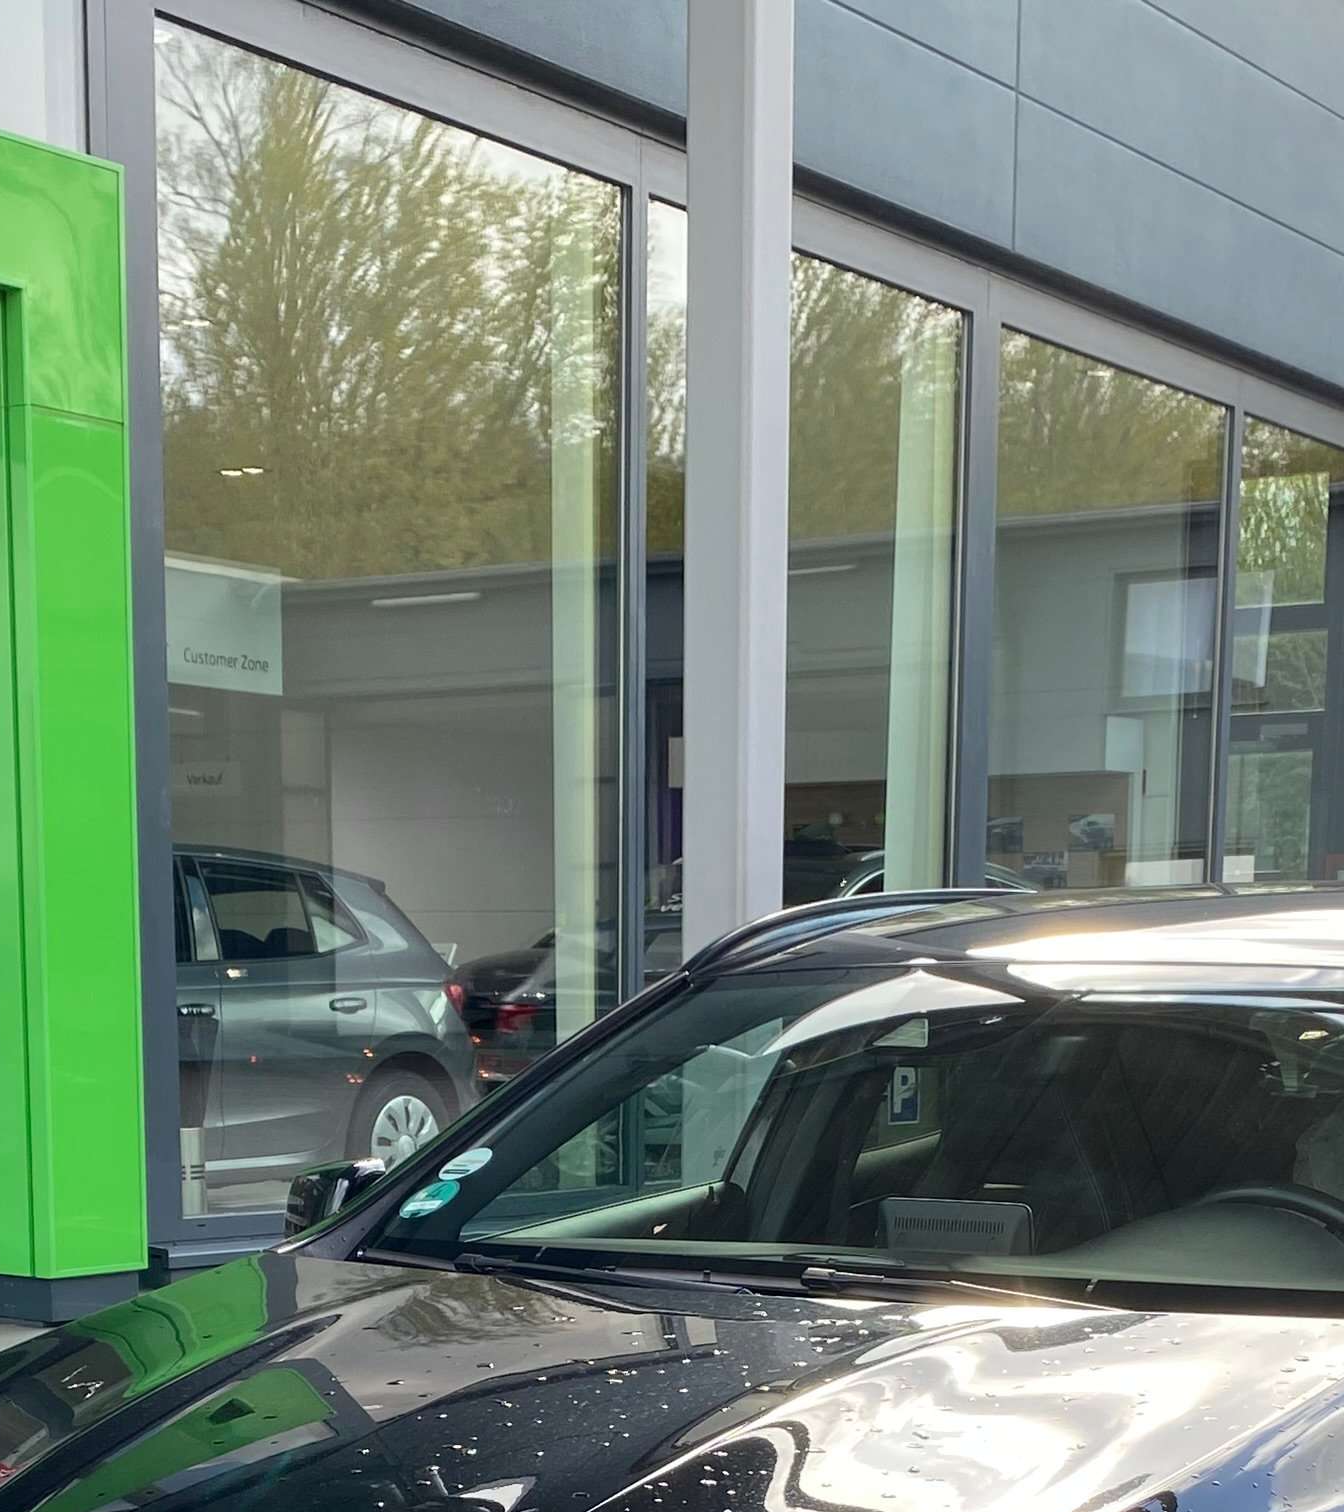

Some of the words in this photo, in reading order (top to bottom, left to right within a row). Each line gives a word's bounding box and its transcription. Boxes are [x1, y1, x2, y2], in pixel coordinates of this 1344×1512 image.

[183, 647, 239, 670] Customer
[241, 654, 270, 673] Zone
[893, 1067, 916, 1114] P
